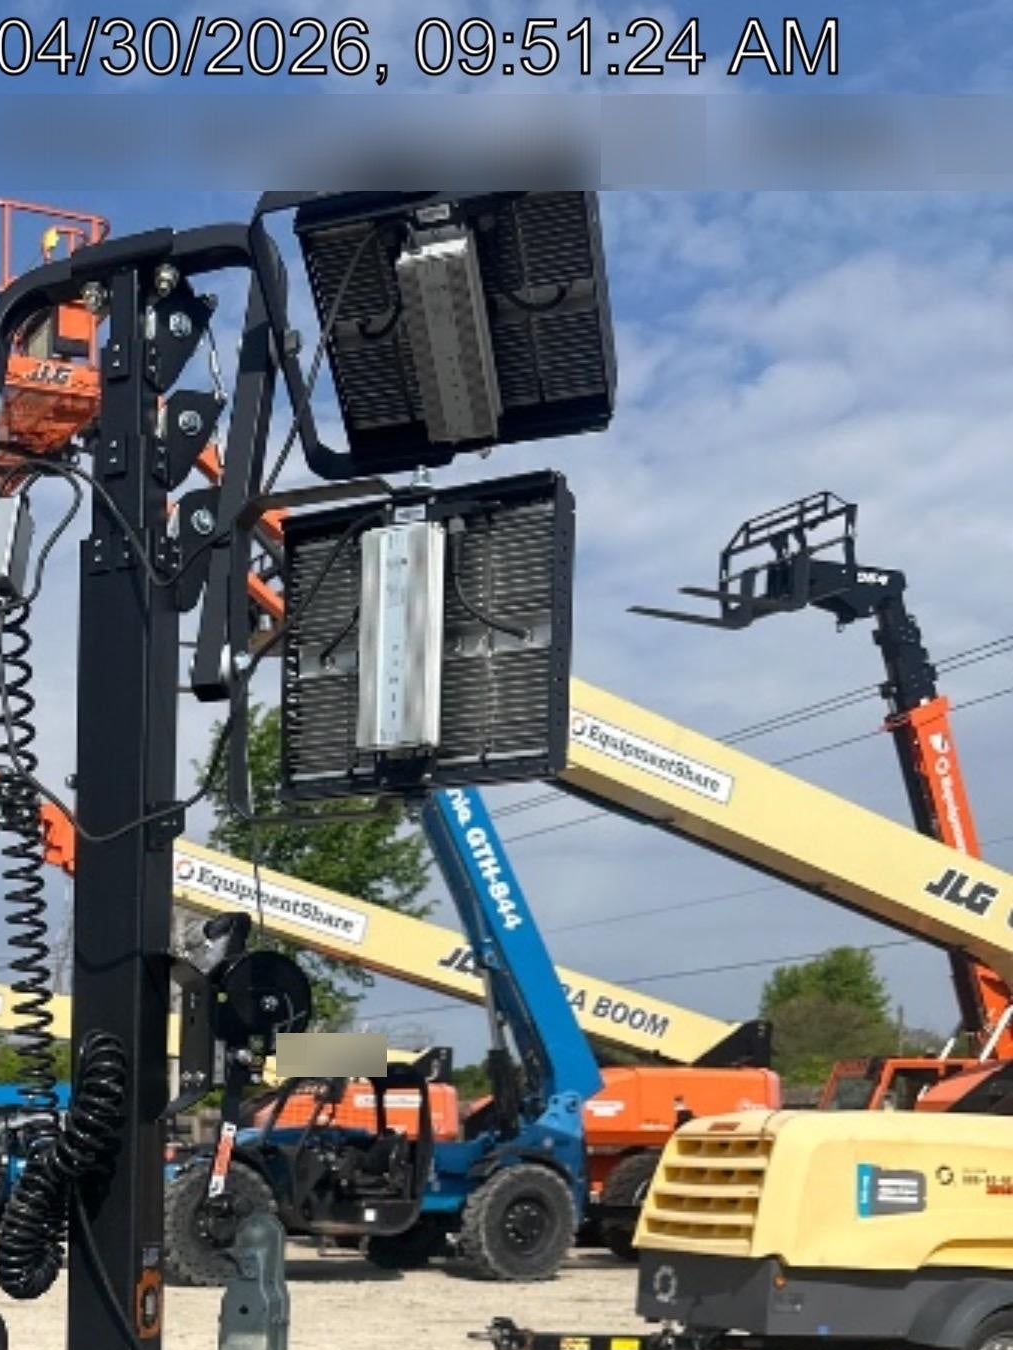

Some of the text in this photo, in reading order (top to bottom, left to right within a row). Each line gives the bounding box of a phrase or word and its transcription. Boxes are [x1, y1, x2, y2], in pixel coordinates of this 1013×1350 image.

[587, 724, 721, 794] EquipmentShare
[195, 865, 356, 934] EquipmentShare
[466, 826, 523, 931] GTH-844
[924, 868, 999, 916] JLG
[591, 995, 670, 1038] BOOM
